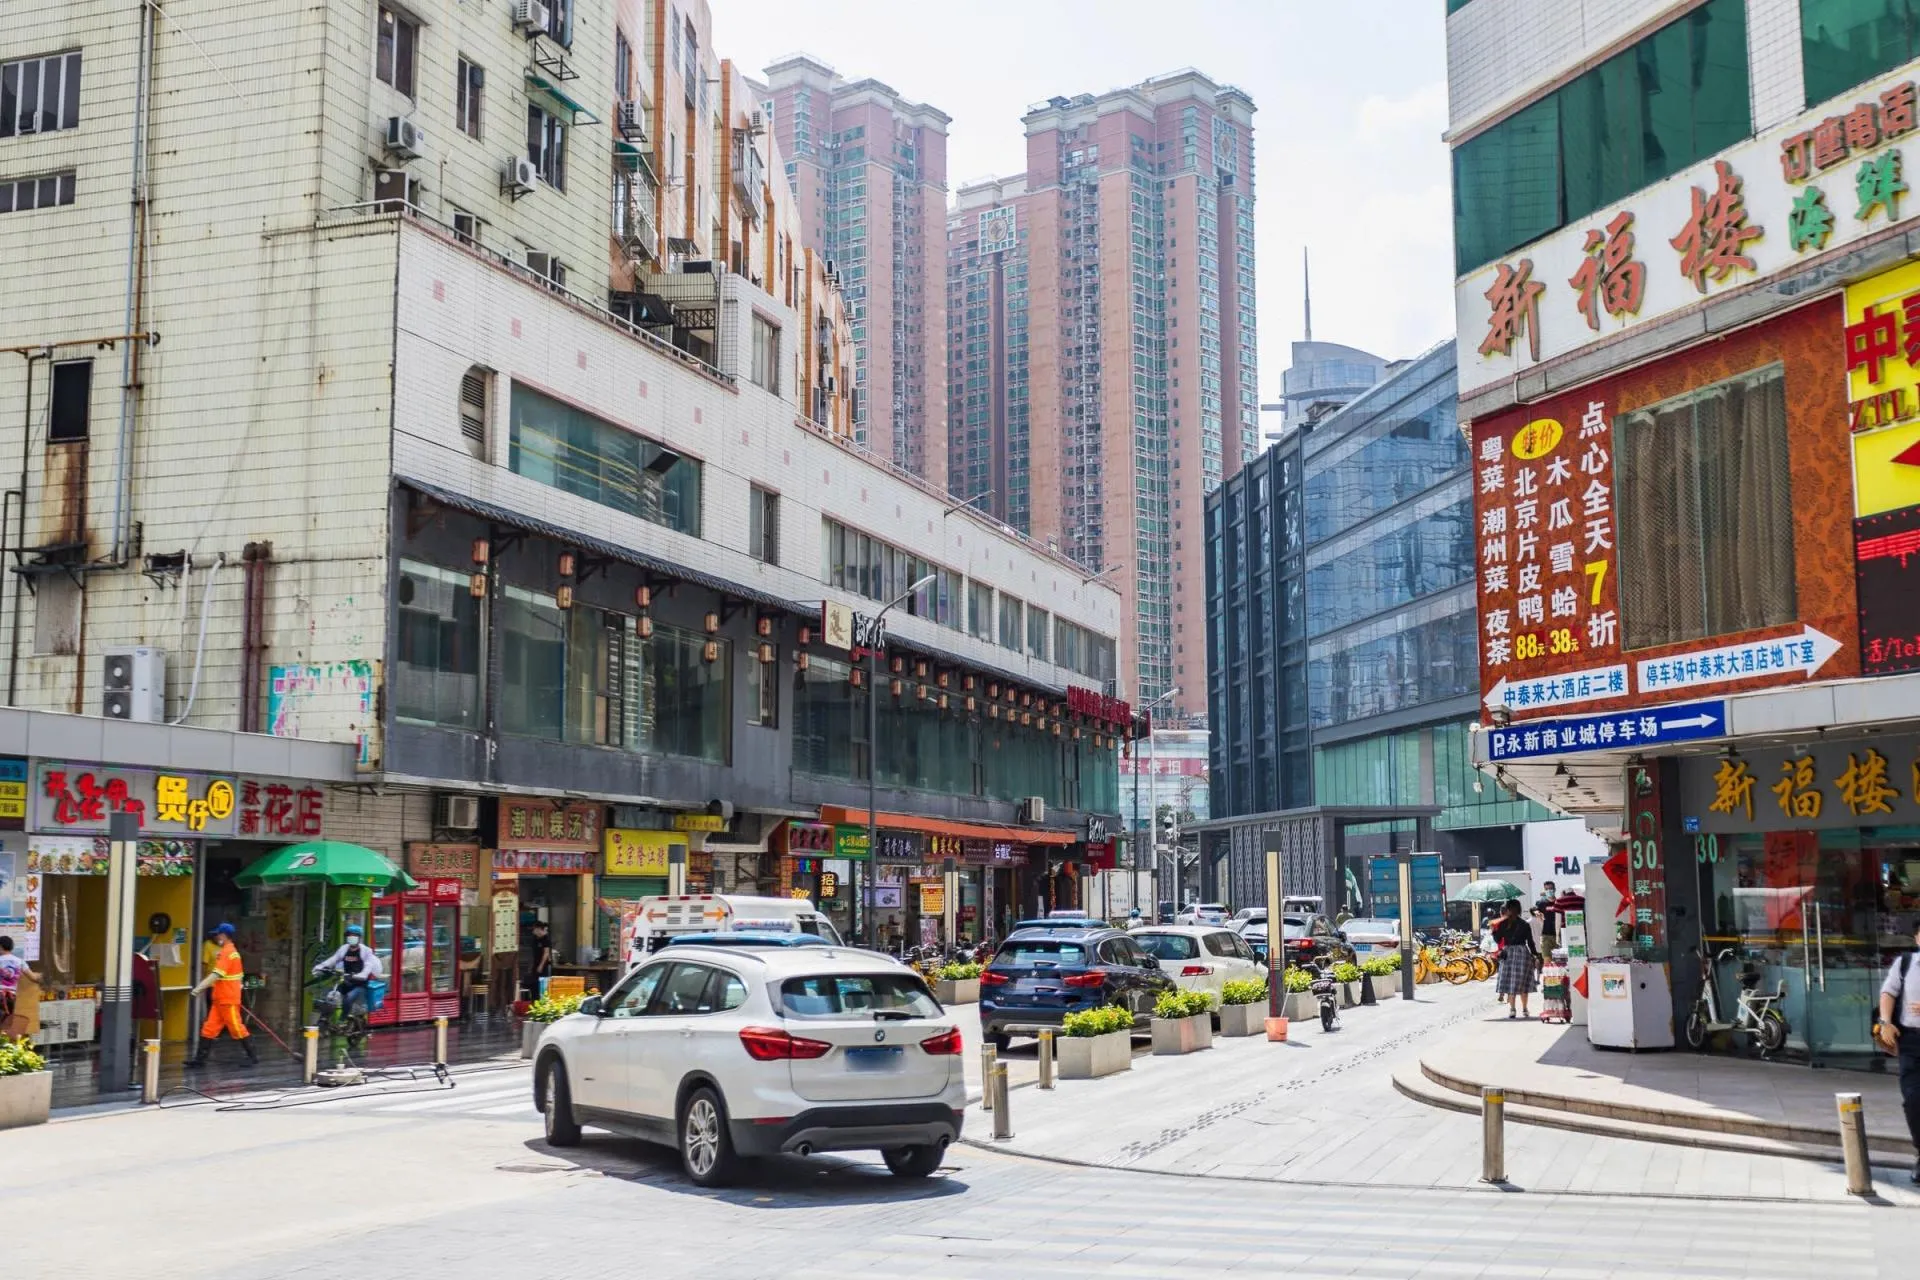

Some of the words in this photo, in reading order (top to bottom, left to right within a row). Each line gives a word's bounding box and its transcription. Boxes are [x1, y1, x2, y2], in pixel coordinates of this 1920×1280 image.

[1789, 148, 1910, 252] 海鲜
[1479, 160, 1764, 362] 新福楼
[1521, 422, 1555, 456] 特价
[1479, 435, 1505, 495] 粤菜
[1513, 467, 1544, 626] 北京片皮鸭
[1578, 400, 1617, 648] 点心全天7折
[1481, 506, 1509, 594] 潮州菜
[1485, 608, 1511, 666] 夜茶
[1516, 633, 1546, 660] 88元
[1550, 628, 1580, 655] 38元
[1503, 671, 1624, 706] 中泰来大酒店二楼
[1645, 638, 1816, 689] 停车场中泰来大酒店地下室
[1506, 716, 1658, 754] 永新商业城停车场
[155, 775, 235, 832] 煲仔饭
[263, 783, 324, 835] 花店
[1553, 855, 1582, 875] FILA
[1633, 839, 1657, 870] 30
[1695, 832, 1718, 864] 30
[820, 873, 836, 898] 招牌
